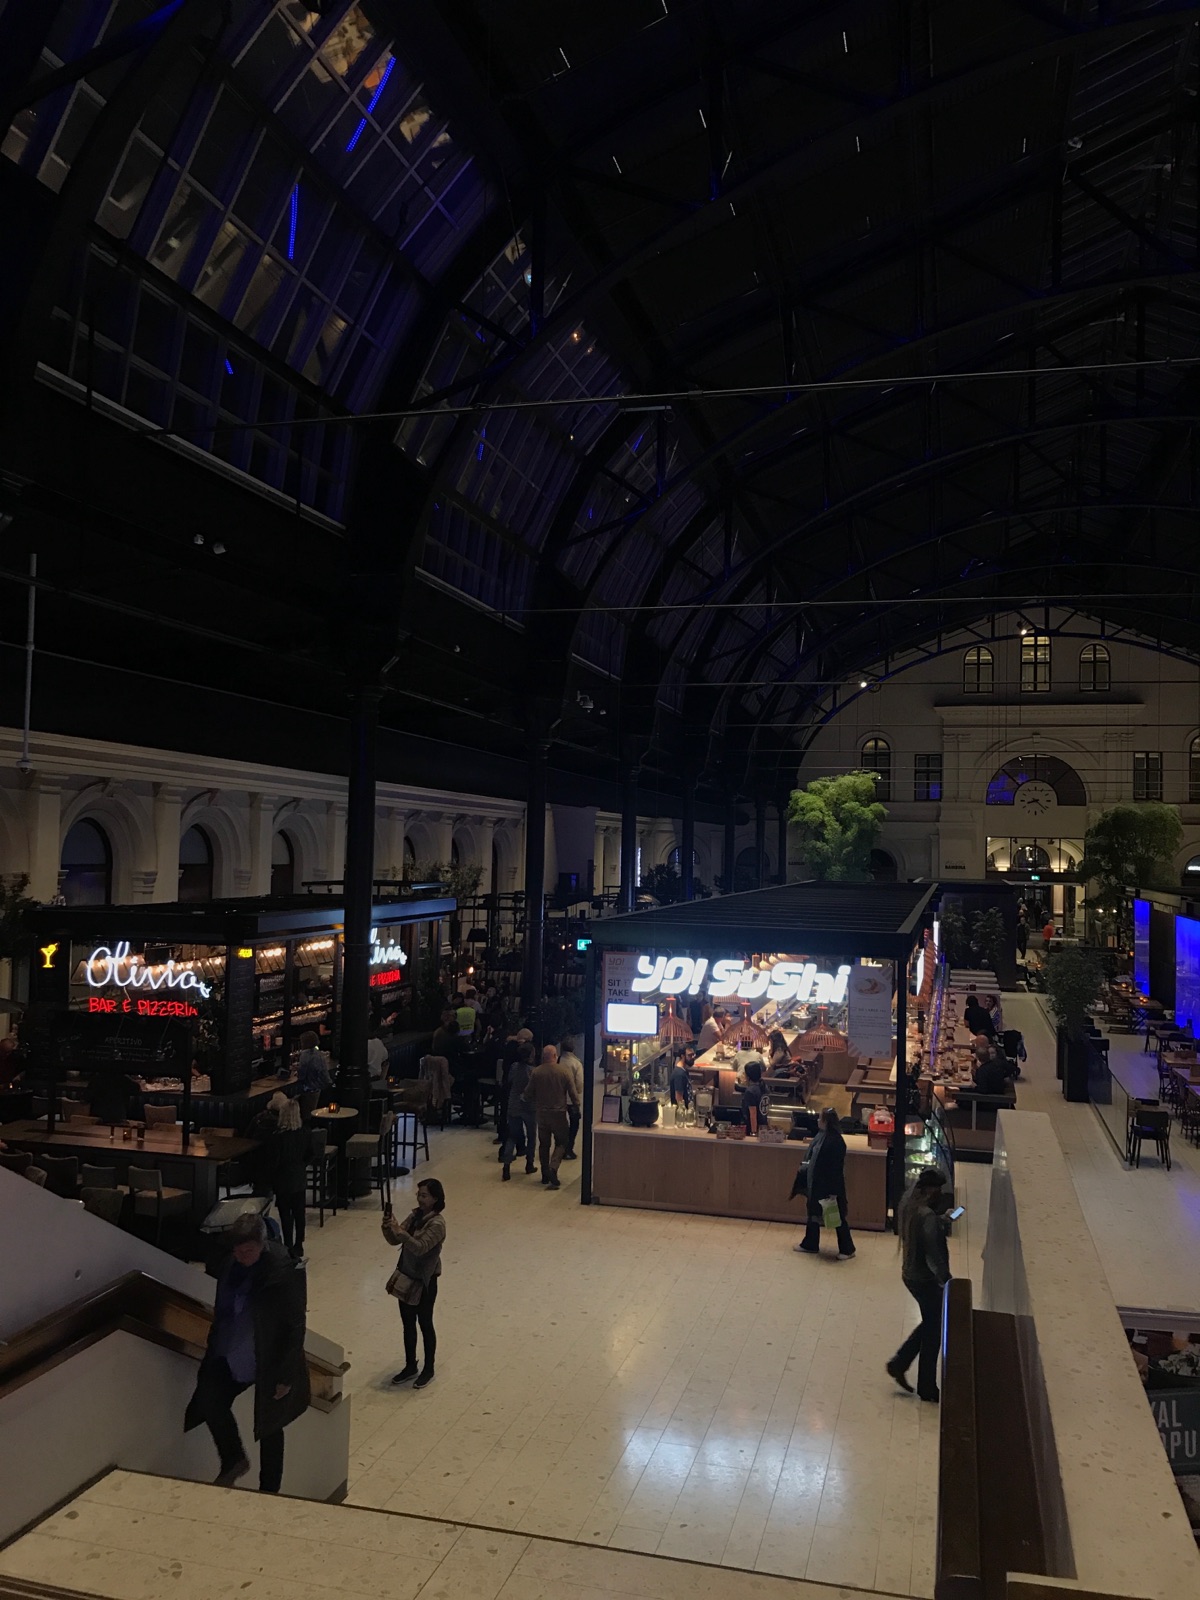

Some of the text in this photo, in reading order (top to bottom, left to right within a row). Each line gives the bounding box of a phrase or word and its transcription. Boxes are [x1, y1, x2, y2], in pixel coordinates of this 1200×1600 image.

[87, 941, 212, 998] Olivia
[632, 955, 708, 995] YO!
[607, 978, 621, 987] SIT
[608, 988, 629, 997] TAKE
[88, 997, 116, 1013] BAR
[137, 1000, 198, 1017] PIZZERIA
[1151, 1400, 1182, 1428] AL
